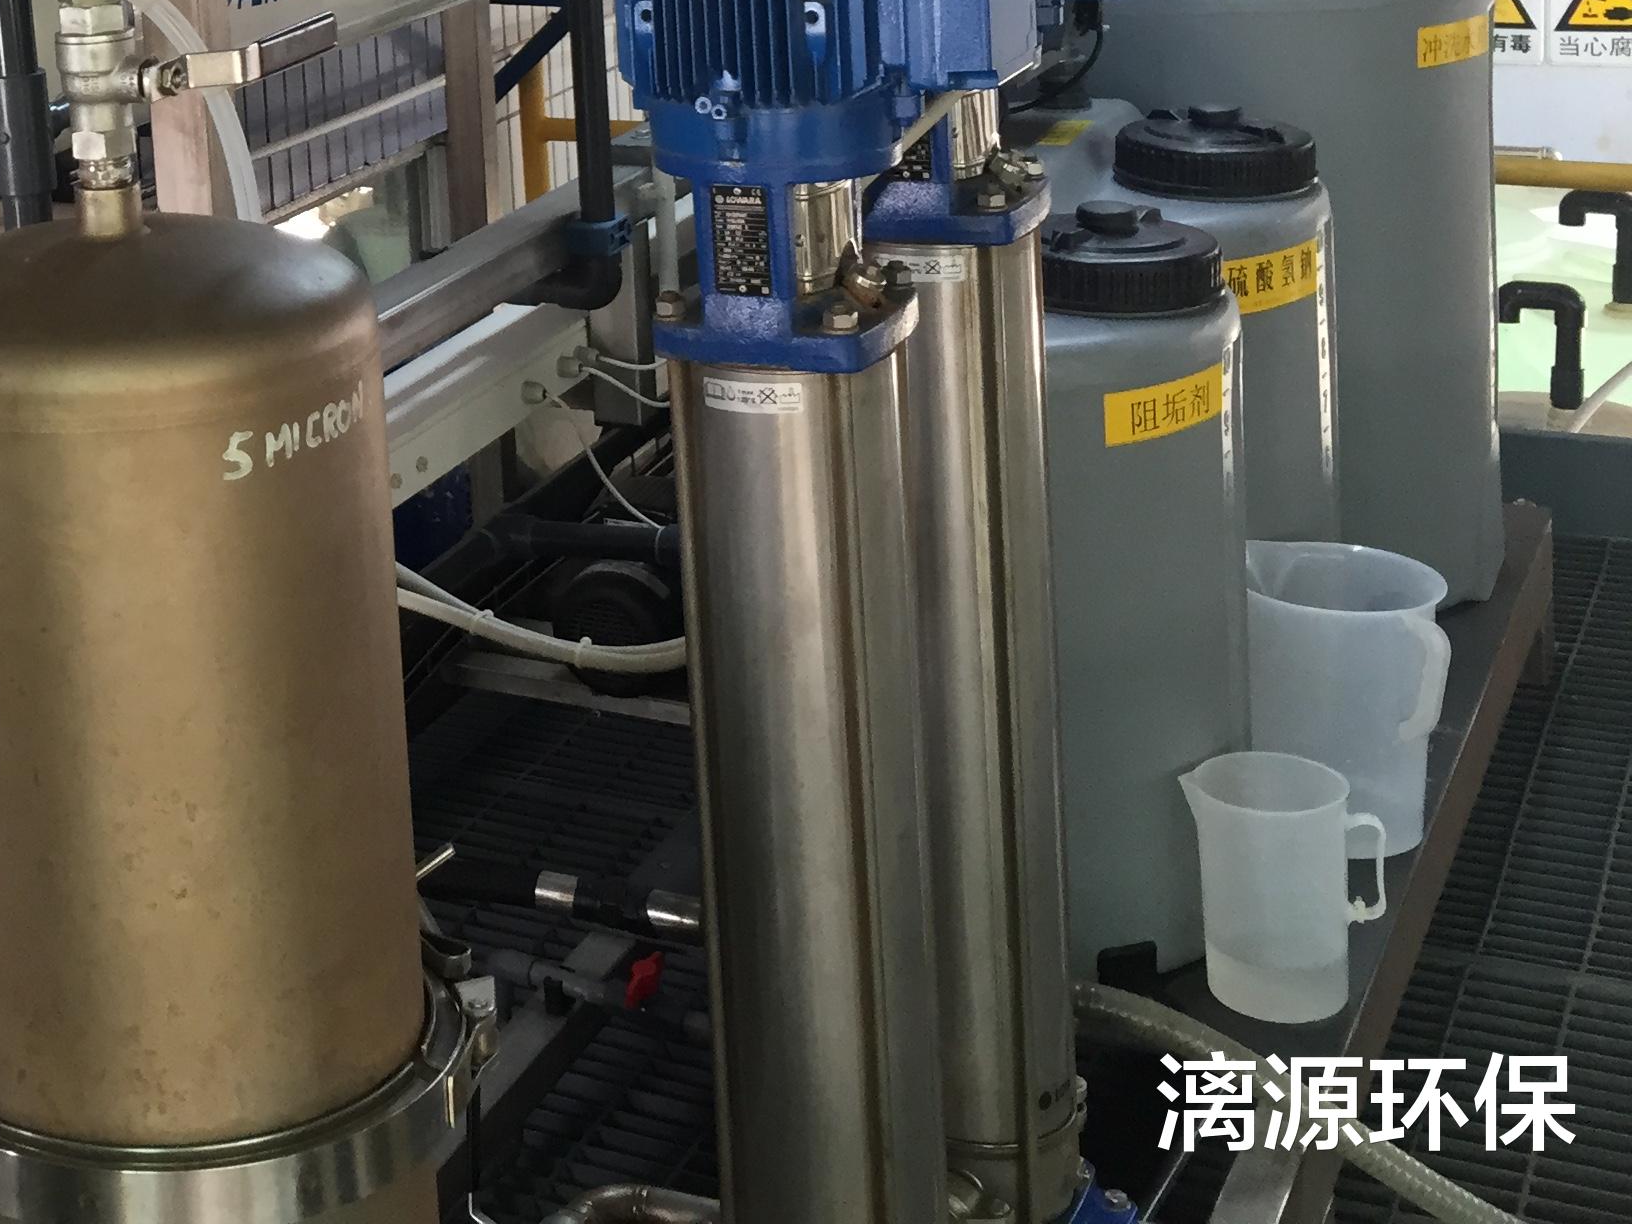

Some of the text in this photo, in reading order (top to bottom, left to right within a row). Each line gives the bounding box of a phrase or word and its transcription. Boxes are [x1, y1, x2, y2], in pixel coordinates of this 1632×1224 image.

[222, 380, 364, 480] 5 MICRON
[1130, 381, 1210, 435] 阻垢剂
